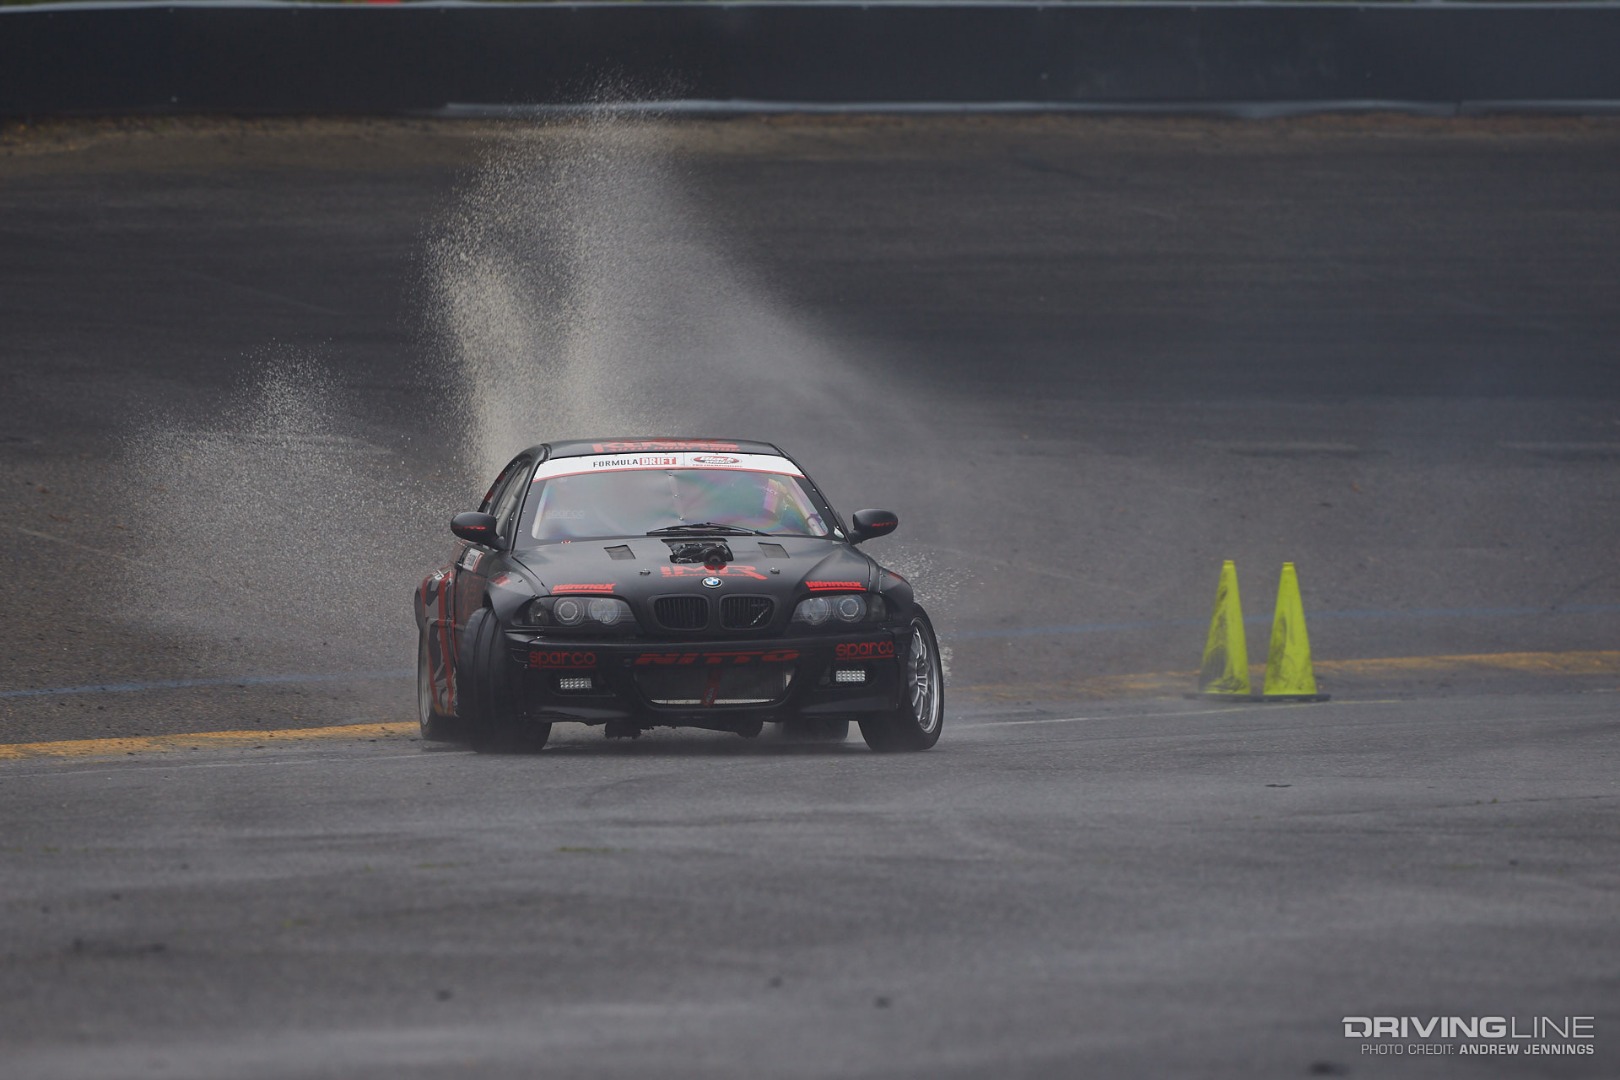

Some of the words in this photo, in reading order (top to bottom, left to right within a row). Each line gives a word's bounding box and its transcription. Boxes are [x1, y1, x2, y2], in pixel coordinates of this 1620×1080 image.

[593, 459, 639, 468] FORMULA
[641, 457, 676, 466] DRIFT
[528, 650, 597, 668] sparco
[634, 649, 800, 665] NITTO
[834, 641, 895, 660] sparco
